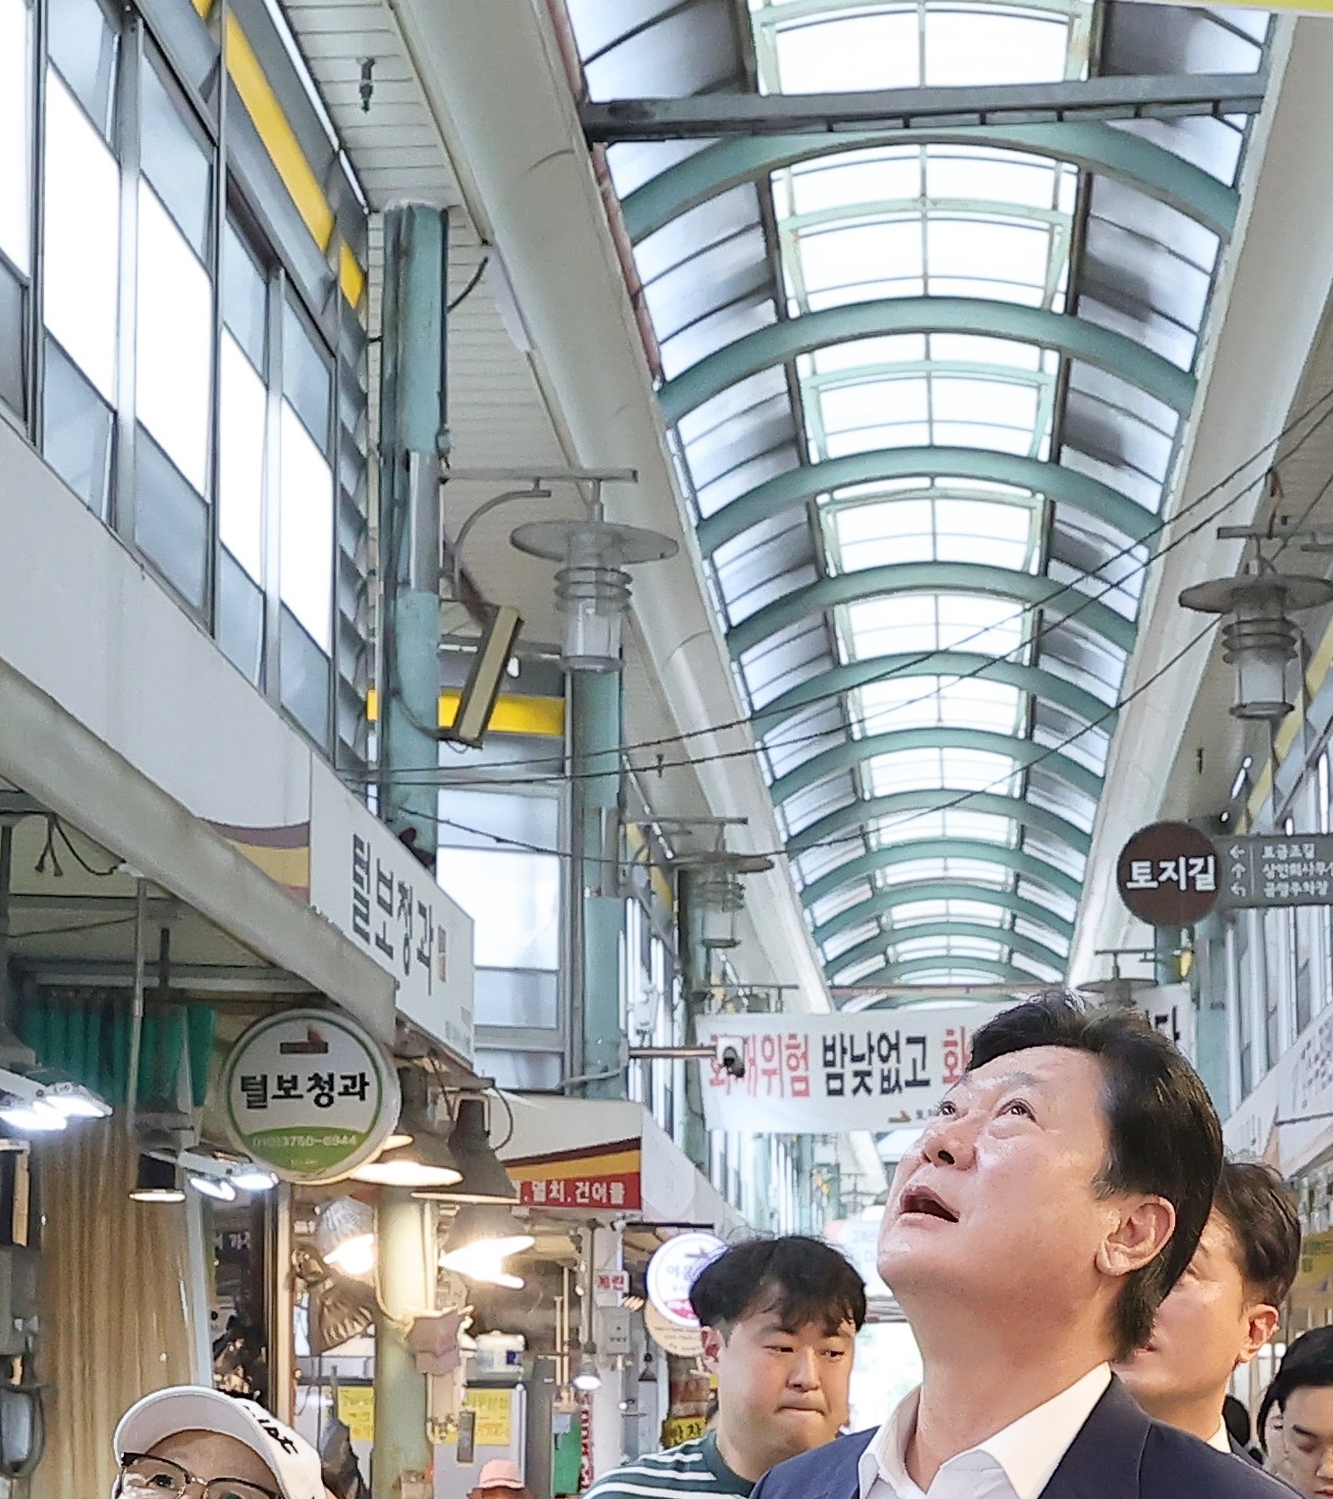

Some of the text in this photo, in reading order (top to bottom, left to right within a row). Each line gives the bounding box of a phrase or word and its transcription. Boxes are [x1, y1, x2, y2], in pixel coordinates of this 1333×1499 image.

[1125, 855, 1217, 892] 토지길
[352, 832, 434, 997] 털보청과
[821, 1030, 931, 1097] 밤낮없고
[240, 1072, 370, 1110] 털보청과
